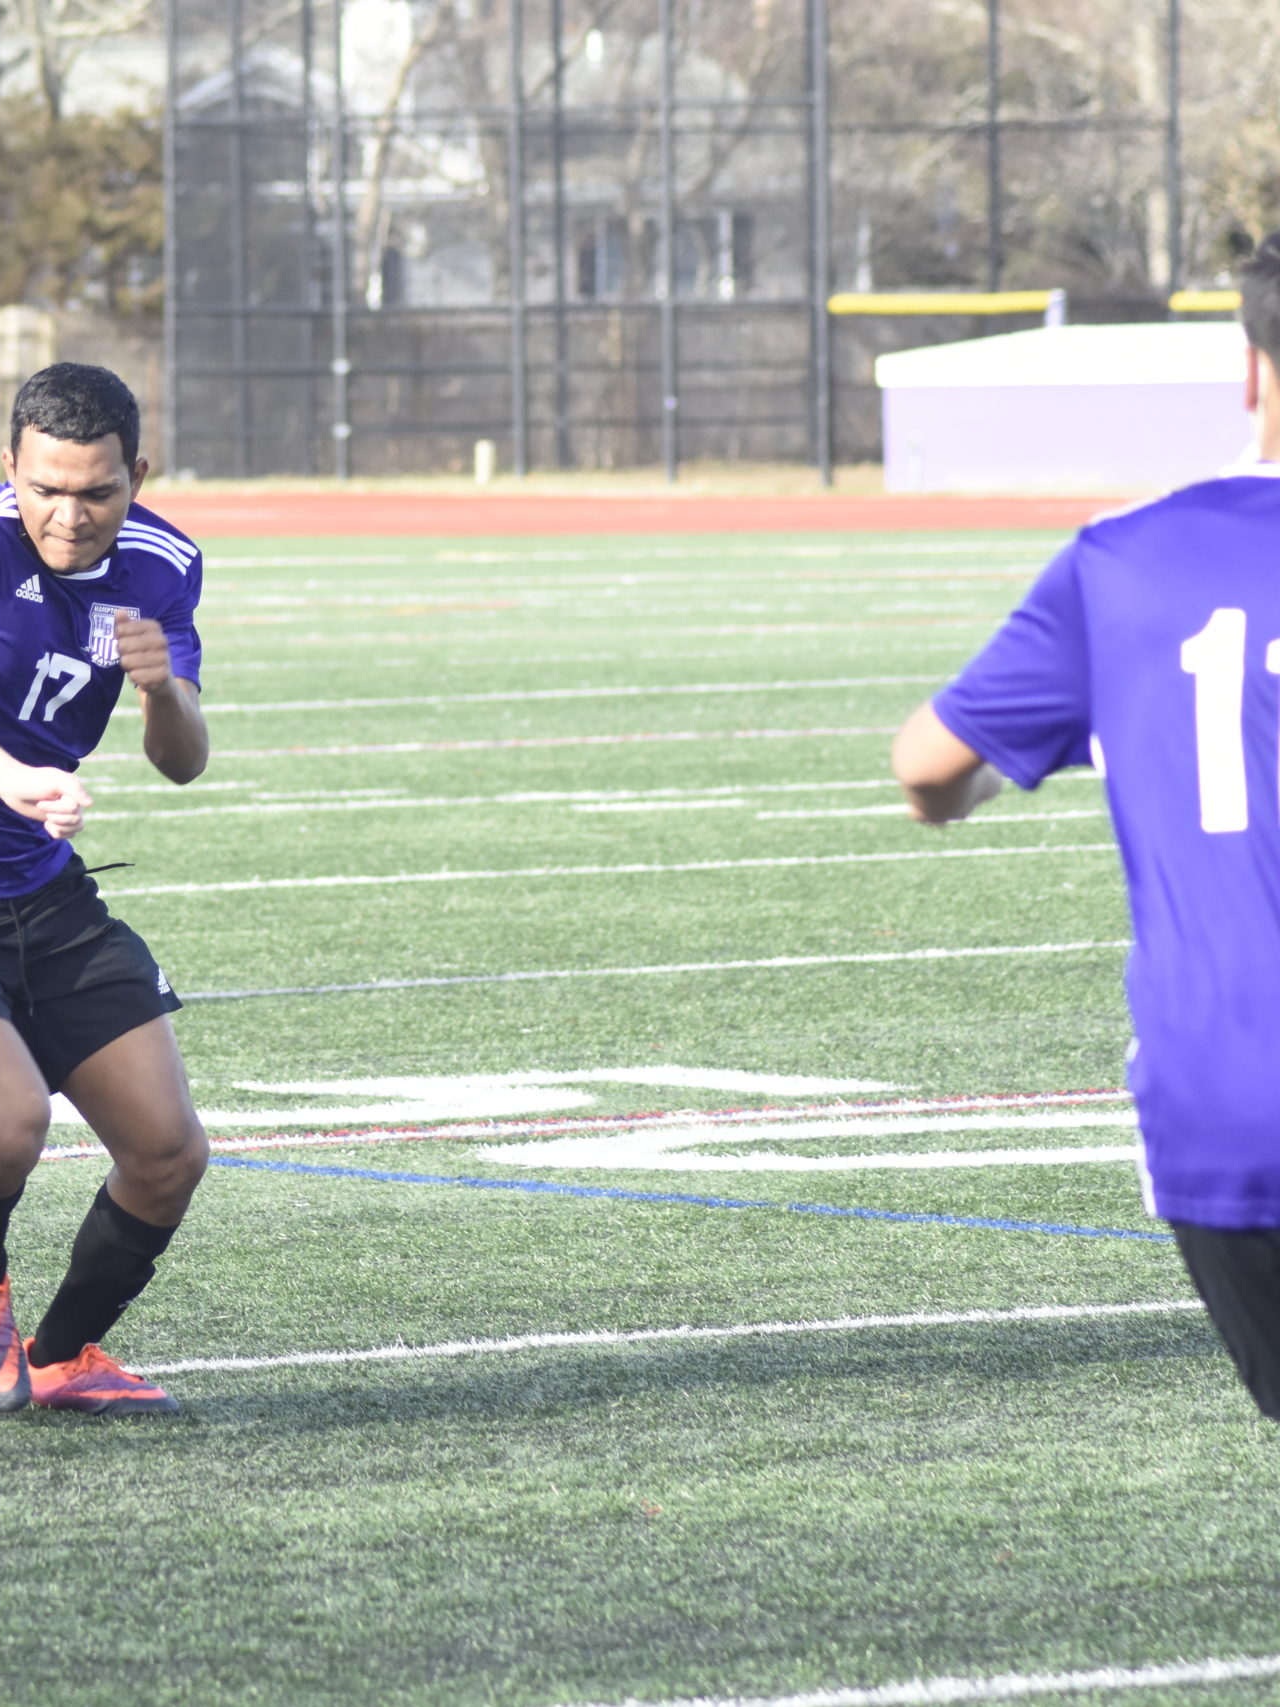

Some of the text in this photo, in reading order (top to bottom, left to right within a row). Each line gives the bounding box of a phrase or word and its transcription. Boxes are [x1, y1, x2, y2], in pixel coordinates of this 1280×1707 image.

[15, 588, 44, 603] adidas
[93, 605, 119, 615] HAMPTO
[17, 651, 92, 722] 17
[1180, 607, 1280, 834] 1
